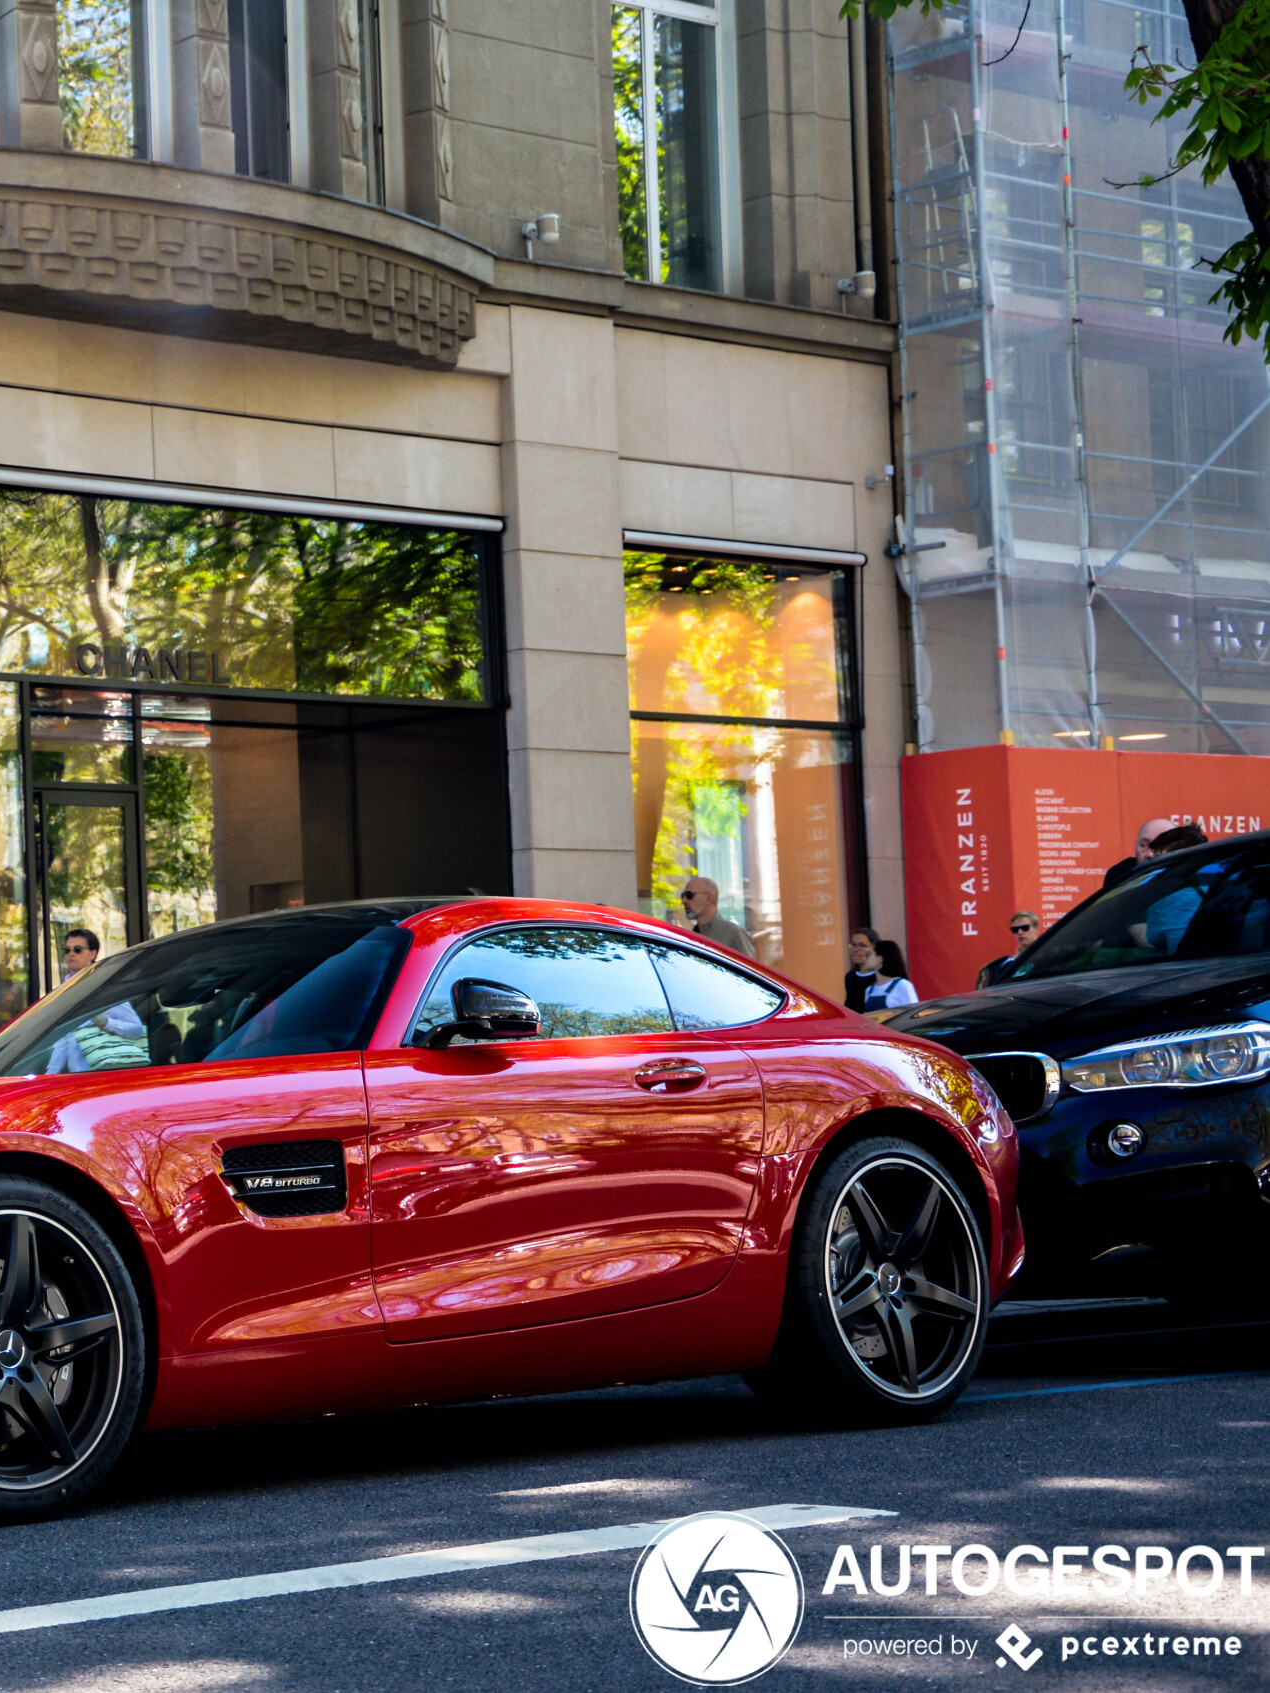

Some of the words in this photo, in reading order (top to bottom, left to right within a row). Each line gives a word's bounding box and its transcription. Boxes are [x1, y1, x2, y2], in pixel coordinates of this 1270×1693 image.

[76, 643, 231, 683] CHANEL
[1059, 806, 1092, 814] COLLECTION
[980, 834, 988, 861] 1820
[956, 788, 978, 936] FRANZEN
[981, 867, 990, 892] SEIT
[245, 1178, 273, 1189] V8
[275, 1177, 321, 1187] BITURBO
